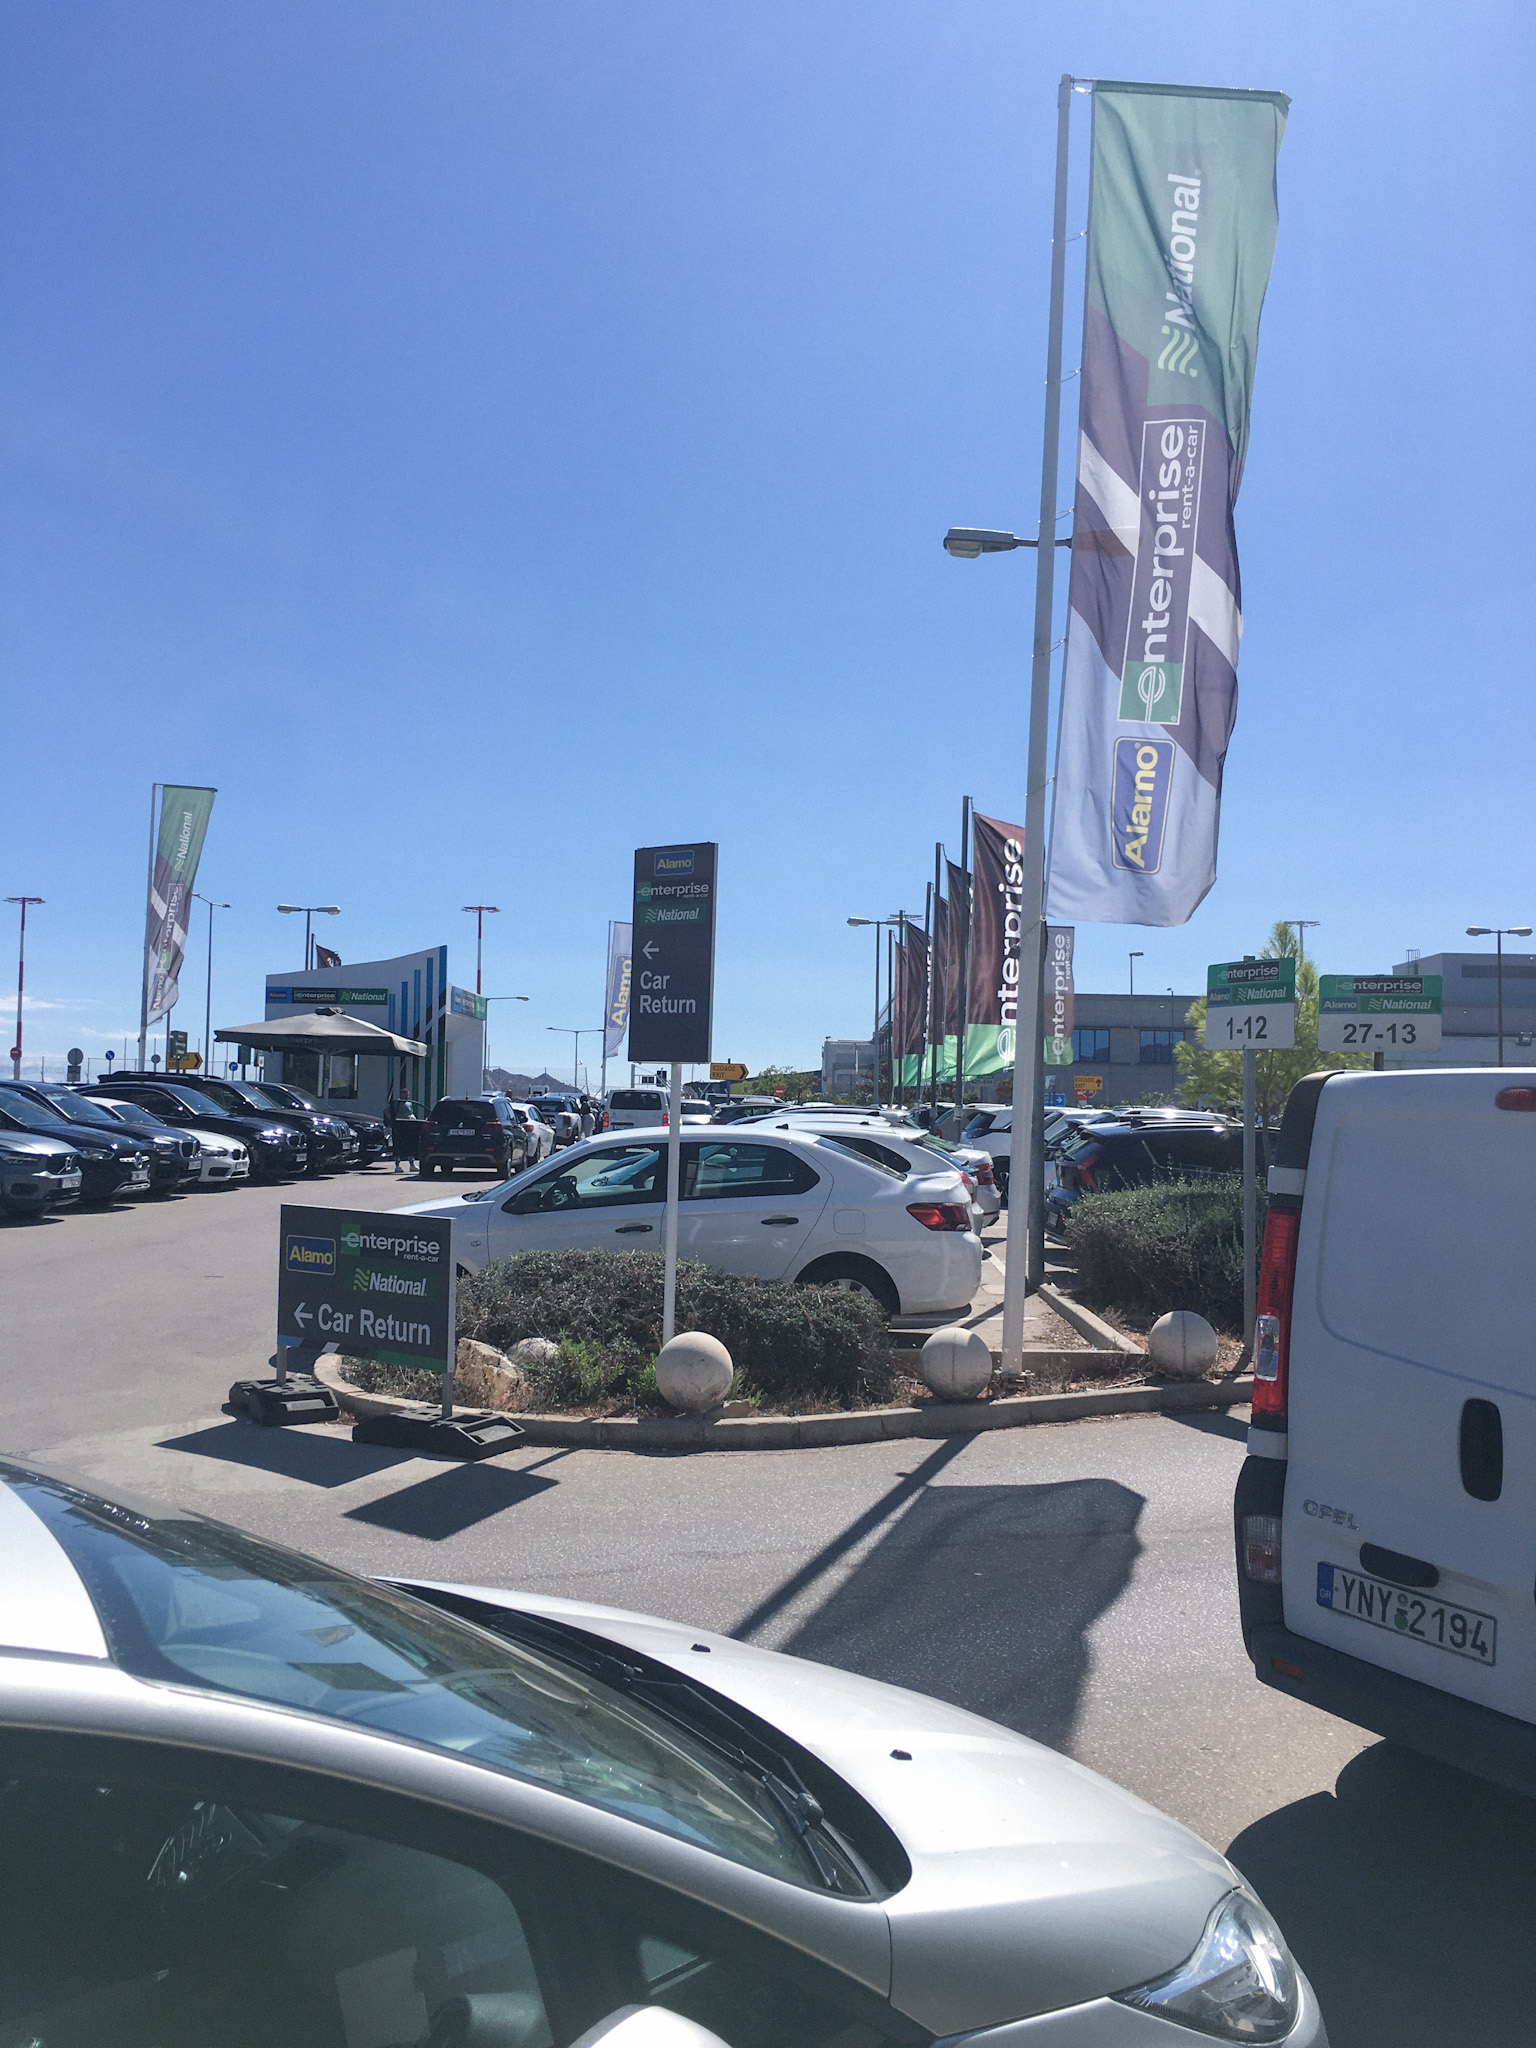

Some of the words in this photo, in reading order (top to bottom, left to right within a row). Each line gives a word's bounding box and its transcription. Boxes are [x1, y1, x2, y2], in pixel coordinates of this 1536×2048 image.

[1165, 173, 1201, 330] National
[1181, 426, 1199, 529] rent-a-car
[1137, 424, 1184, 722] enterprise
[1124, 745, 1158, 869] Alamo
[176, 811, 193, 859] National
[656, 858, 692, 870] Alamo
[638, 882, 710, 899] enterprise
[656, 907, 699, 921] National
[158, 886, 180, 969] eerpris
[640, 970, 670, 990] Car
[1217, 964, 1280, 980] enterprise
[351, 992, 386, 1001] National
[611, 958, 632, 1027] Alamo
[1208, 991, 1230, 1002] Alamo
[1246, 986, 1287, 1000] National
[1337, 979, 1422, 993] enterprise
[639, 995, 696, 1014] Return
[1051, 933, 1069, 1064] enterprise
[1323, 1000, 1357, 1010] Alamo
[1381, 998, 1432, 1011] National
[1226, 1015, 1268, 1040] 1-12
[1343, 1023, 1417, 1044] 27-13
[289, 1245, 333, 1265] Alamo
[341, 1231, 440, 1257] enterprise
[403, 1253, 440, 1263] rent-a-car
[369, 1272, 427, 1297] National
[318, 1303, 353, 1334] Car
[359, 1308, 431, 1346] Return
[1302, 1499, 1360, 1531] OPEL
[1319, 1588, 1332, 1599] GR
[1342, 1574, 1393, 1623] YNY
[1408, 1600, 1489, 1658] 2194
